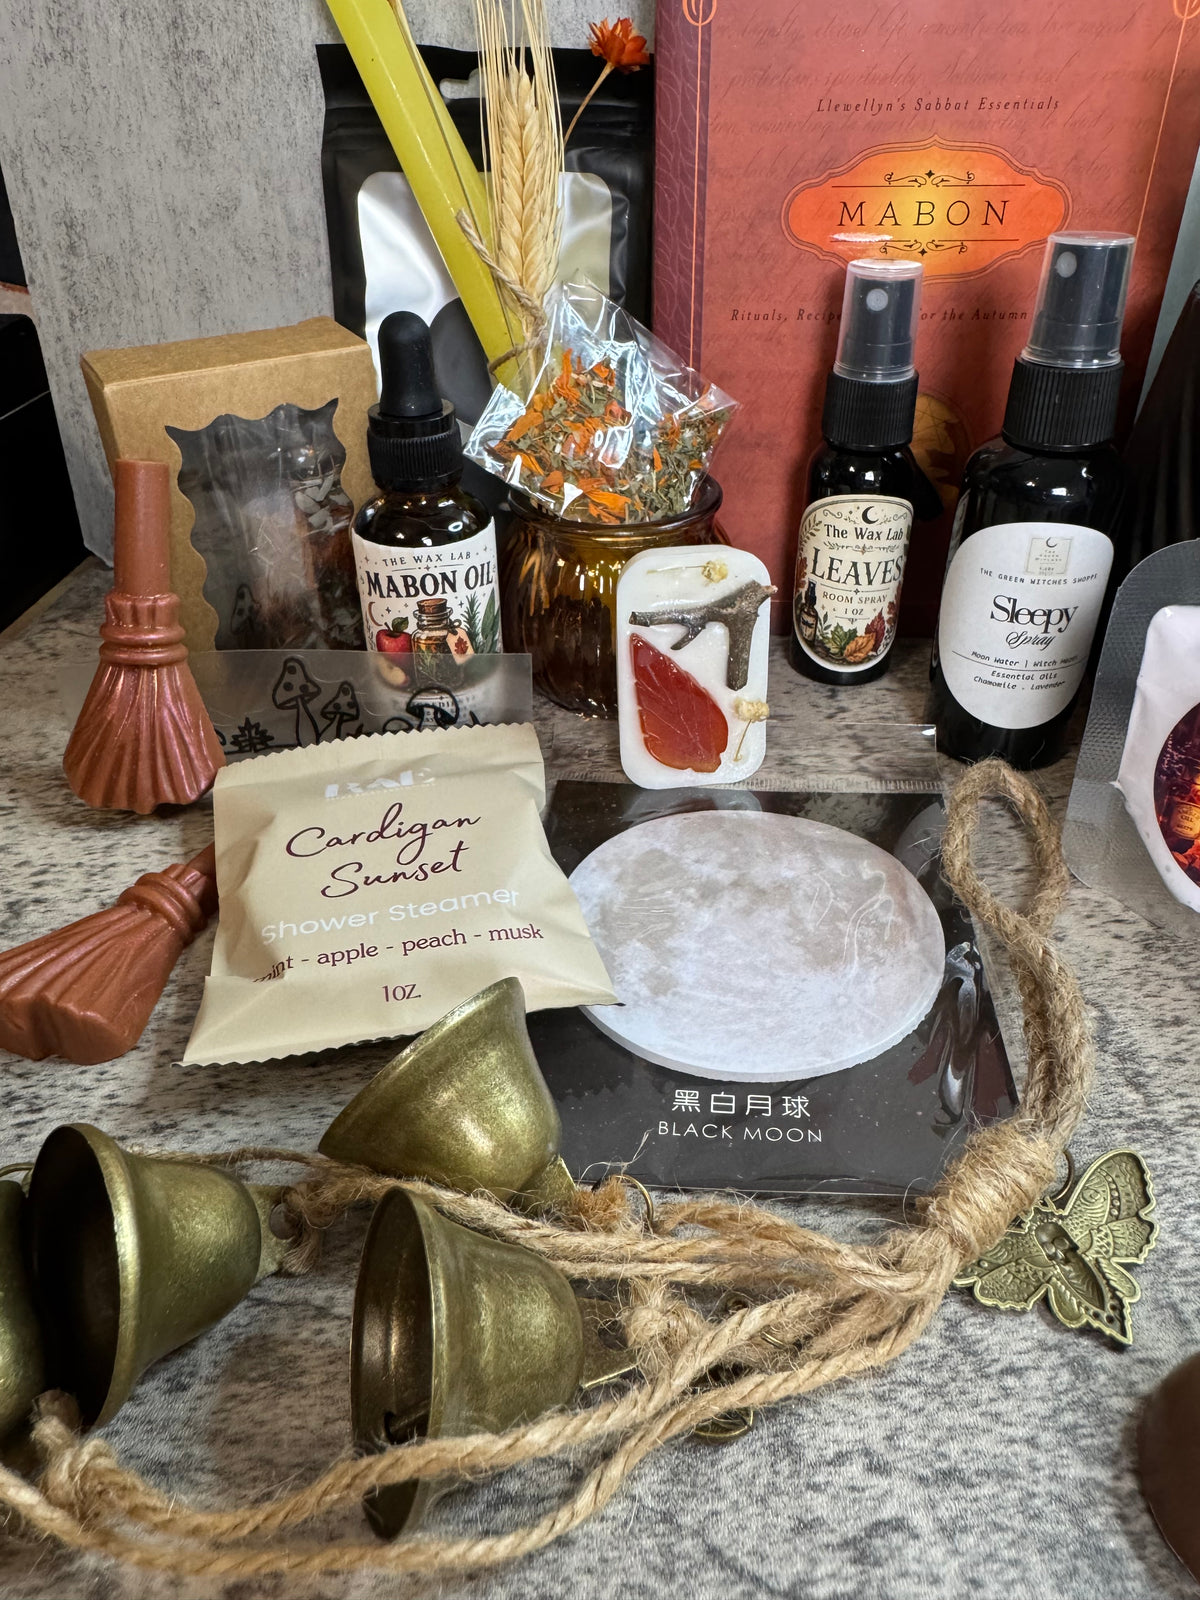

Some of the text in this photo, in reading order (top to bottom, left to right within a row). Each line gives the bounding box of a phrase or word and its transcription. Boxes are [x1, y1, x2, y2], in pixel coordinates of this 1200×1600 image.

[816, 96, 1060, 116] Llewellyn's Sabbat Essentials
[837, 200, 1010, 228] MABON
[730, 306, 1028, 323] Rituals, Recipe or the Autumn
[824, 524, 904, 541] The Wax Lab
[383, 551, 472, 567] THE WAX LAB
[810, 547, 904, 586] LEAVES
[365, 560, 493, 599] MABON OIL
[980, 568, 993, 577] THE
[998, 574, 1025, 583] GREEN
[822, 591, 888, 604] ROOM SPRAY
[990, 595, 1079, 634] Sleepy
[1005, 630, 1056, 651] Spray
[285, 802, 481, 866] Cardigan
[320, 840, 469, 899] Sunset
[261, 887, 519, 945] shower Steamer
[317, 943, 379, 967] apple
[402, 930, 467, 956] peach
[488, 923, 544, 942] musk
[672, 1089, 810, 1118] 黑白月球
[658, 1121, 822, 1142] BLACK MOON
